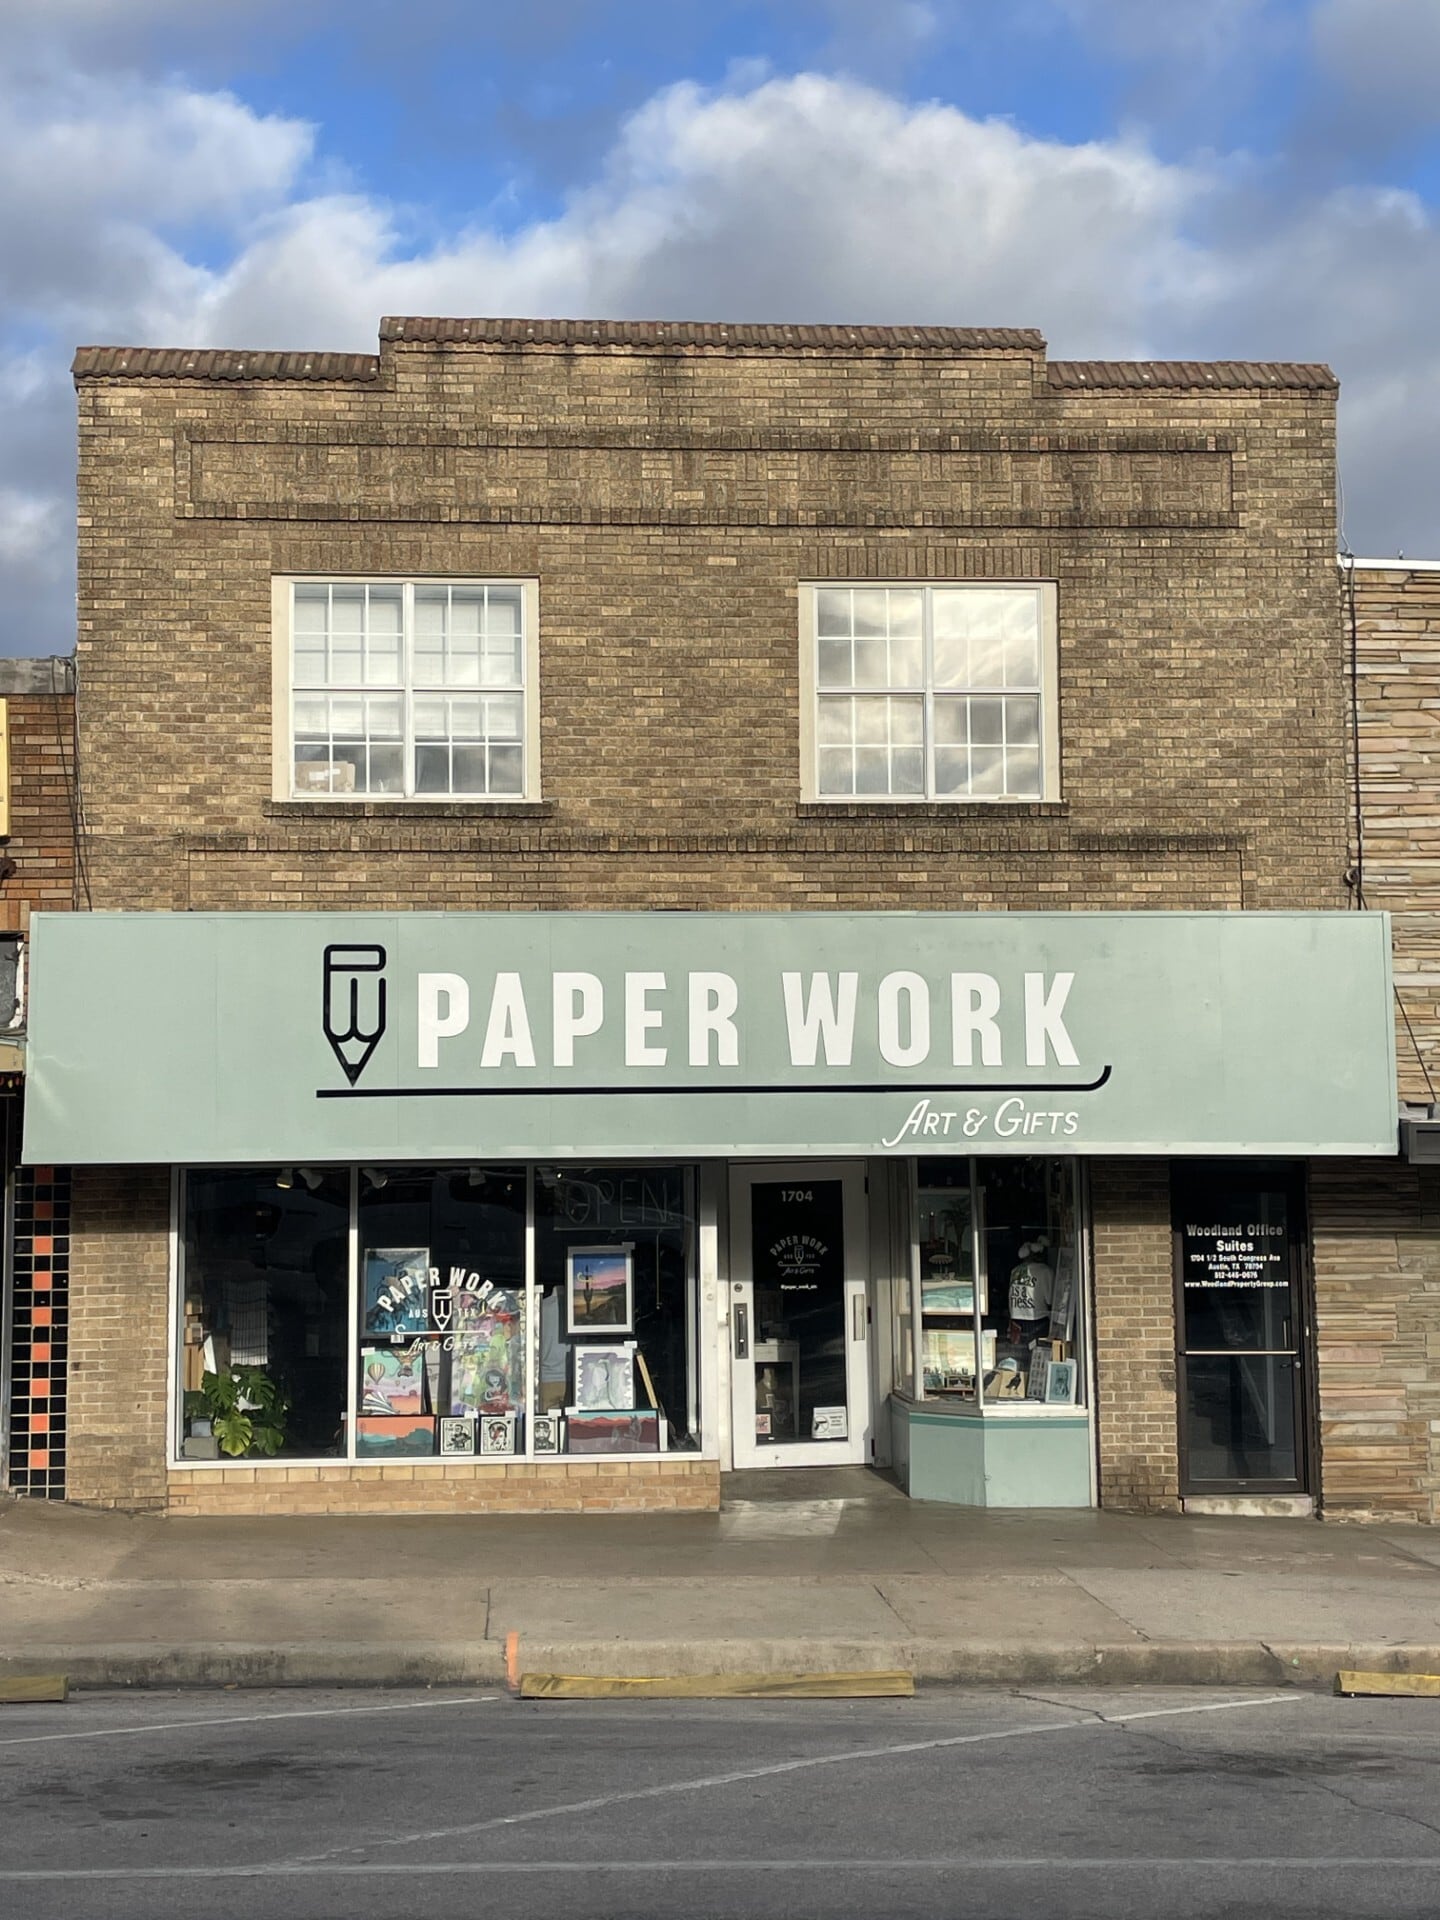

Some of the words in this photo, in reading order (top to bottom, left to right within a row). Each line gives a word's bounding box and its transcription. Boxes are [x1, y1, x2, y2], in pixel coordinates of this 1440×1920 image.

[417, 971, 740, 1069] PAPER
[781, 970, 1081, 1069] WORK
[962, 1108, 989, 1137] &
[781, 1190, 814, 1202] 1704
[1186, 1224, 1242, 1237] Woodland
[1247, 1224, 1284, 1236] Office
[1216, 1240, 1254, 1252] Suites
[377, 1267, 441, 1313] PAPER
[450, 1267, 507, 1310] WORK
[408, 1308, 429, 1318] AUS
